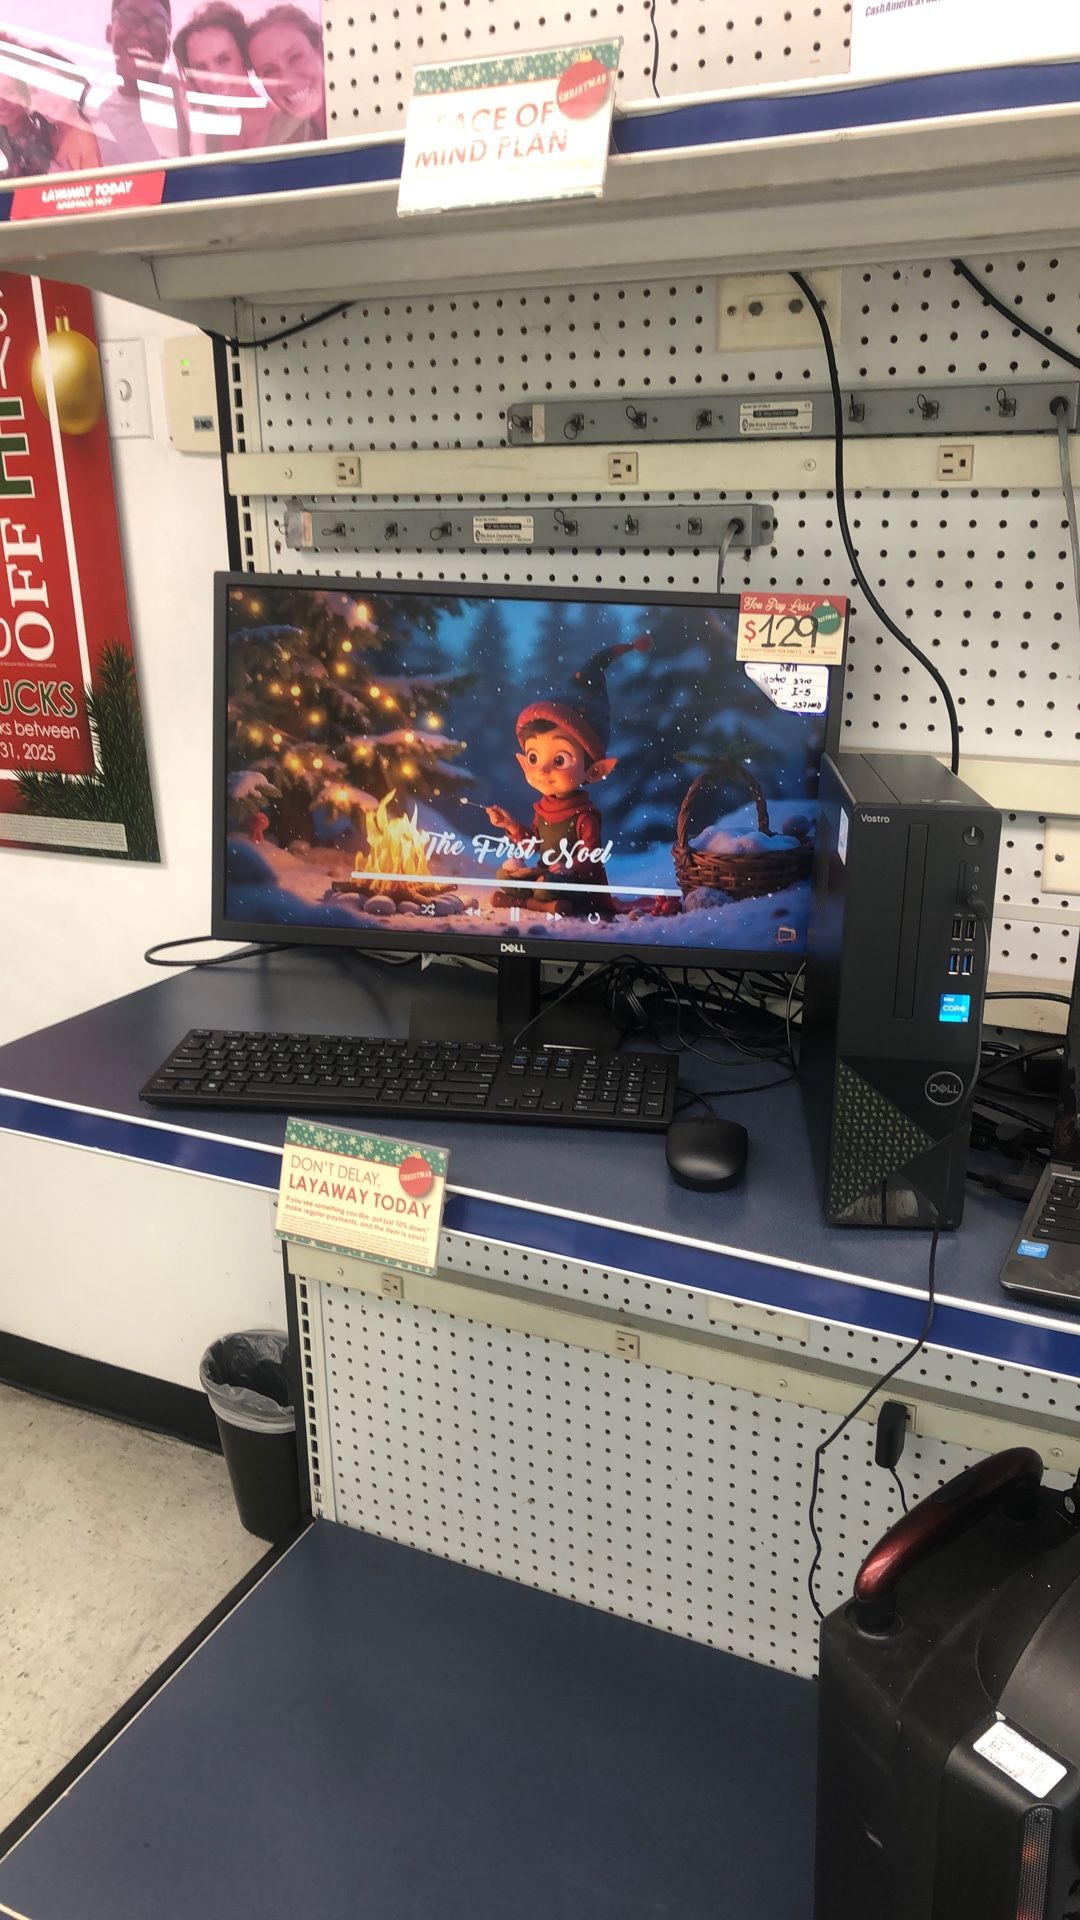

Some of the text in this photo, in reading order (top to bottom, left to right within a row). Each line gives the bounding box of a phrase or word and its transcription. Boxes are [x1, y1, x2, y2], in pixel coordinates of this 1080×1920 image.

[558, 74, 607, 102] CHRISTMAS
[434, 101, 554, 133] ACE OF
[415, 129, 568, 168] MIND PLAN
[41, 180, 133, 202] LAYAWAY TODAY
[0, 517, 55, 661] OFF
[743, 596, 816, 613] You Pay Less!
[0, 679, 78, 718] UCKS
[14, 719, 80, 739] between
[22, 742, 56, 761] 2025
[861, 813, 890, 823] Vostro
[426, 831, 614, 869] The First Noel
[501, 943, 526, 953] DELL
[930, 1083, 959, 1094] DELL
[291, 1154, 335, 1176] DON'T
[400, 1170, 432, 1181] CHRISTMAS
[289, 1173, 431, 1219] LAYAWAY TODAY
[315, 1202, 345, 1215] something
